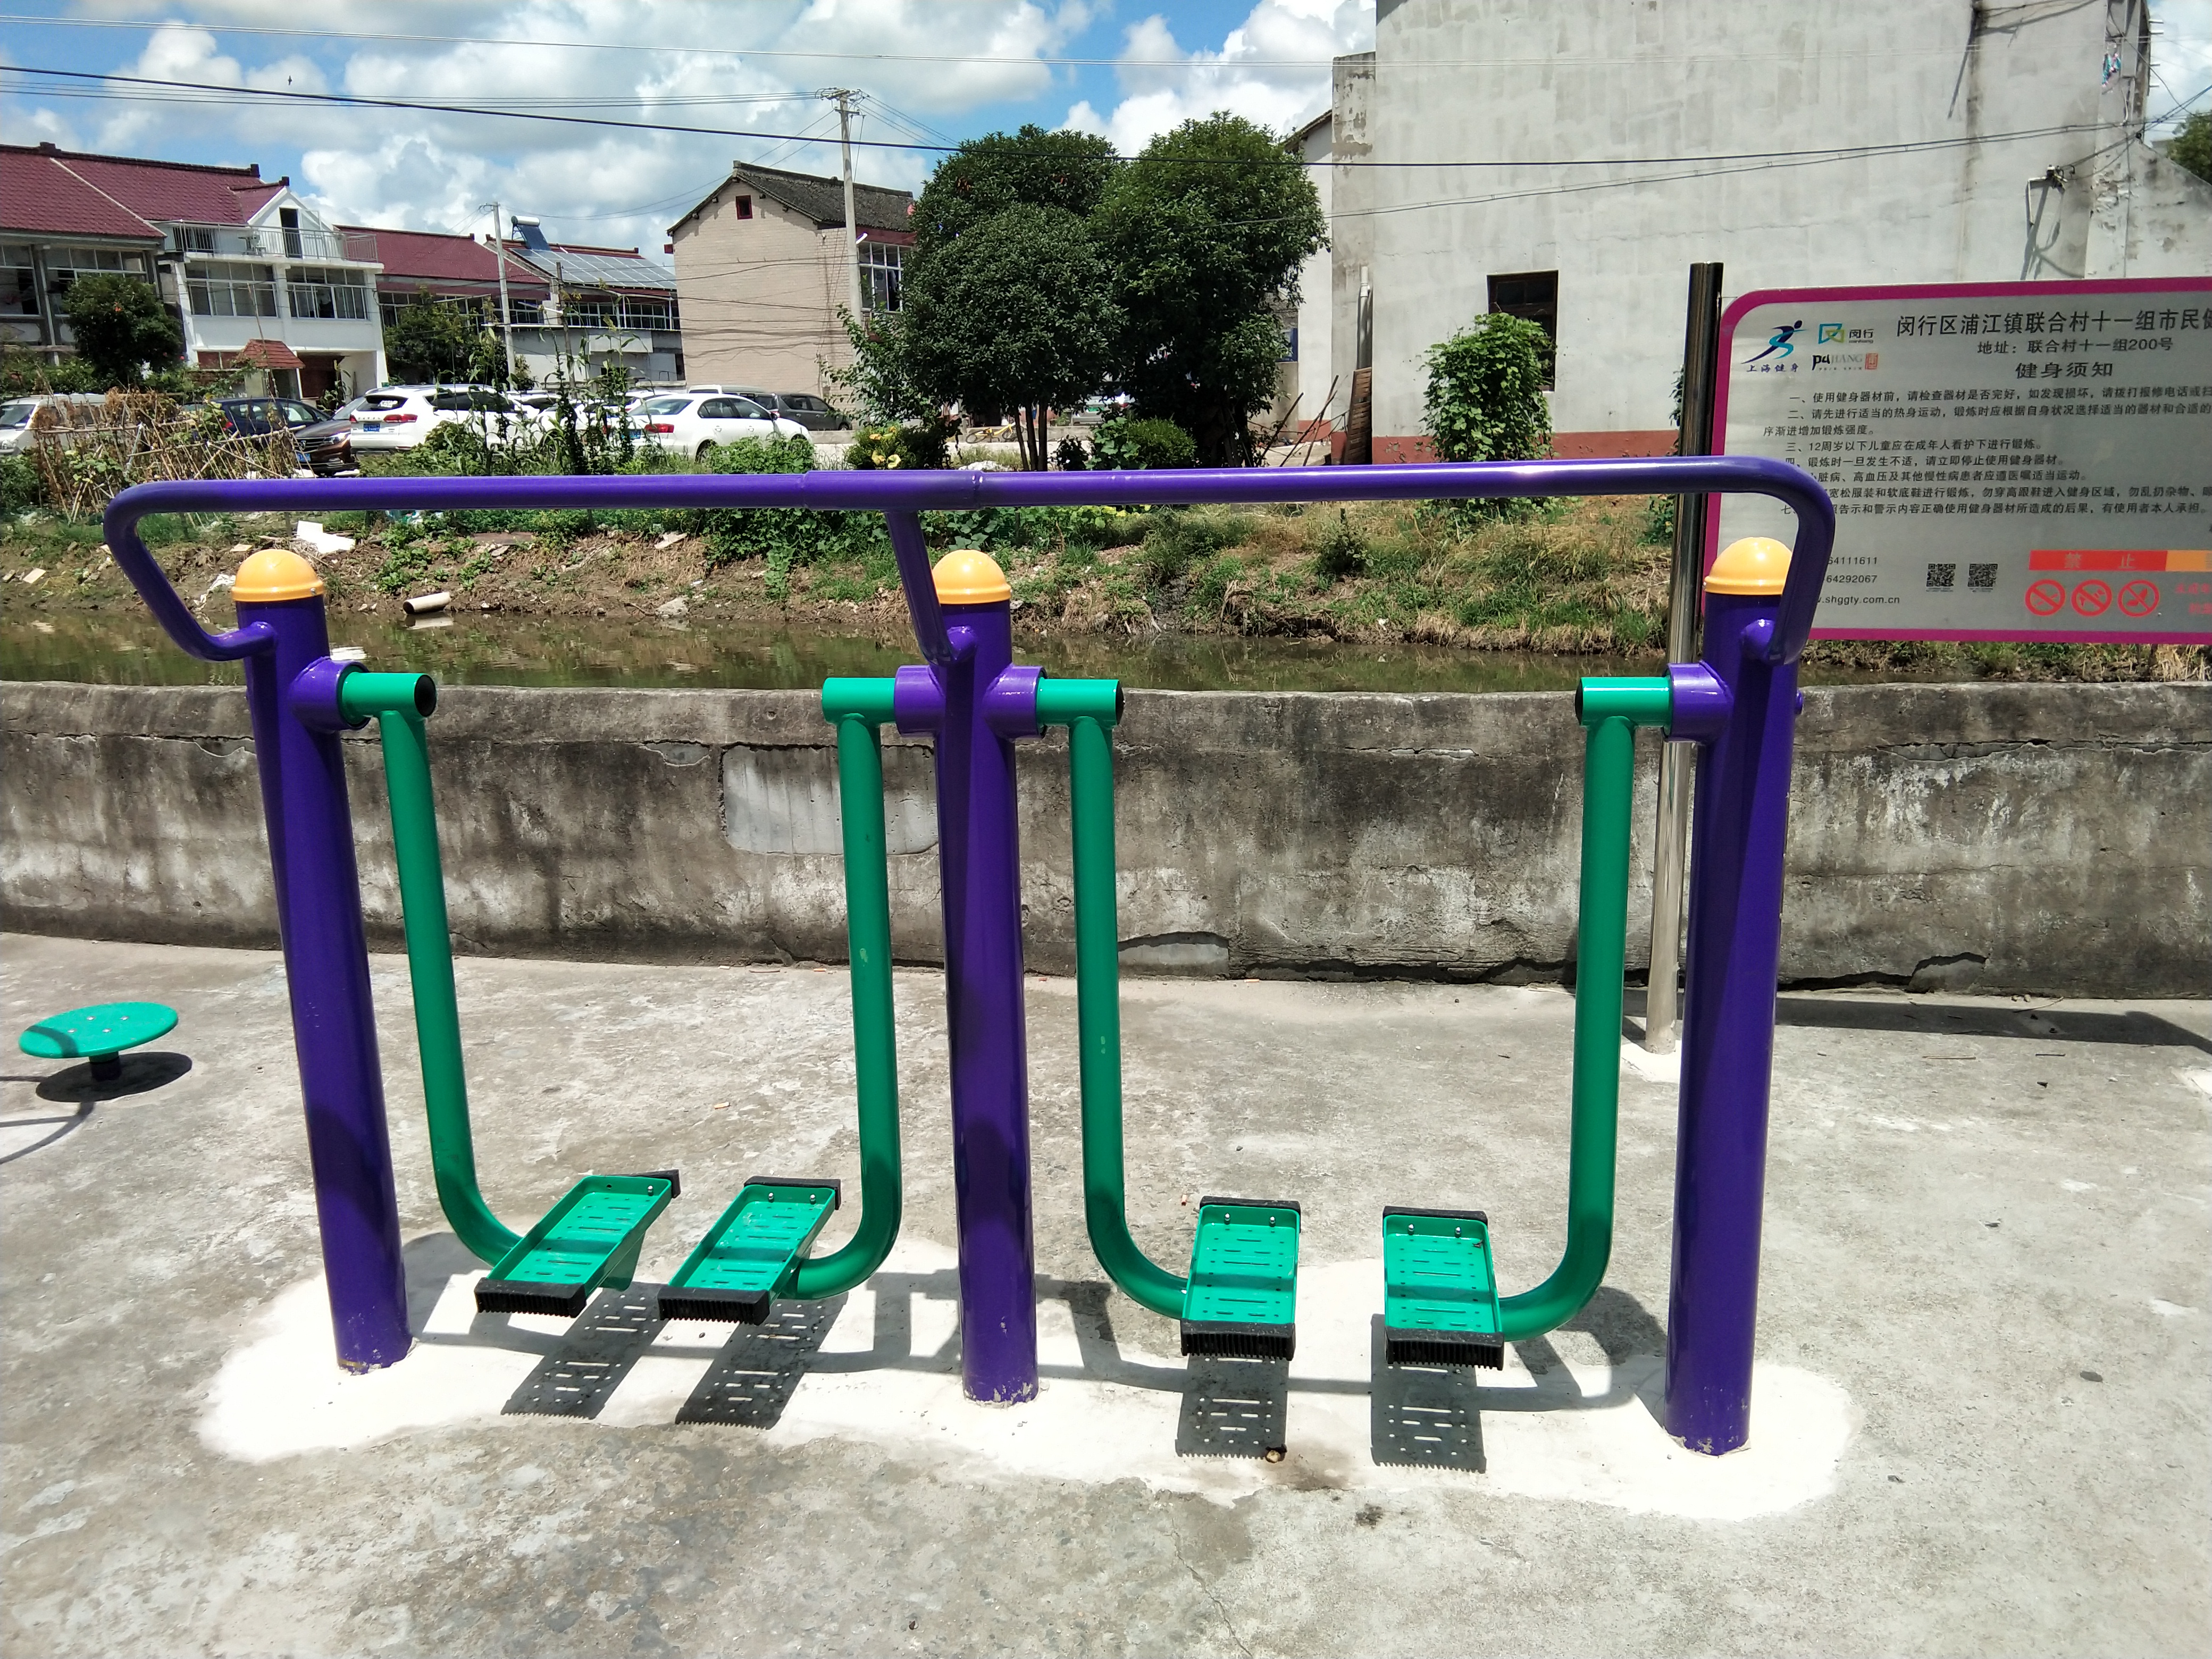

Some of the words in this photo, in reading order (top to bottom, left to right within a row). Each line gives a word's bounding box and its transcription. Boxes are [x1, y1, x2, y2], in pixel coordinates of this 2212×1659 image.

[1849, 329, 1874, 339] 闵行
[2015, 362, 2113, 379] 健身须知
[1763, 424, 1873, 437] 序渐进增加锻炼强度。
[1786, 438, 2041, 452] 三、12周岁以下儿童应在成年人看护下进行锻炼。
[2065, 552, 2136, 570] 禁止
